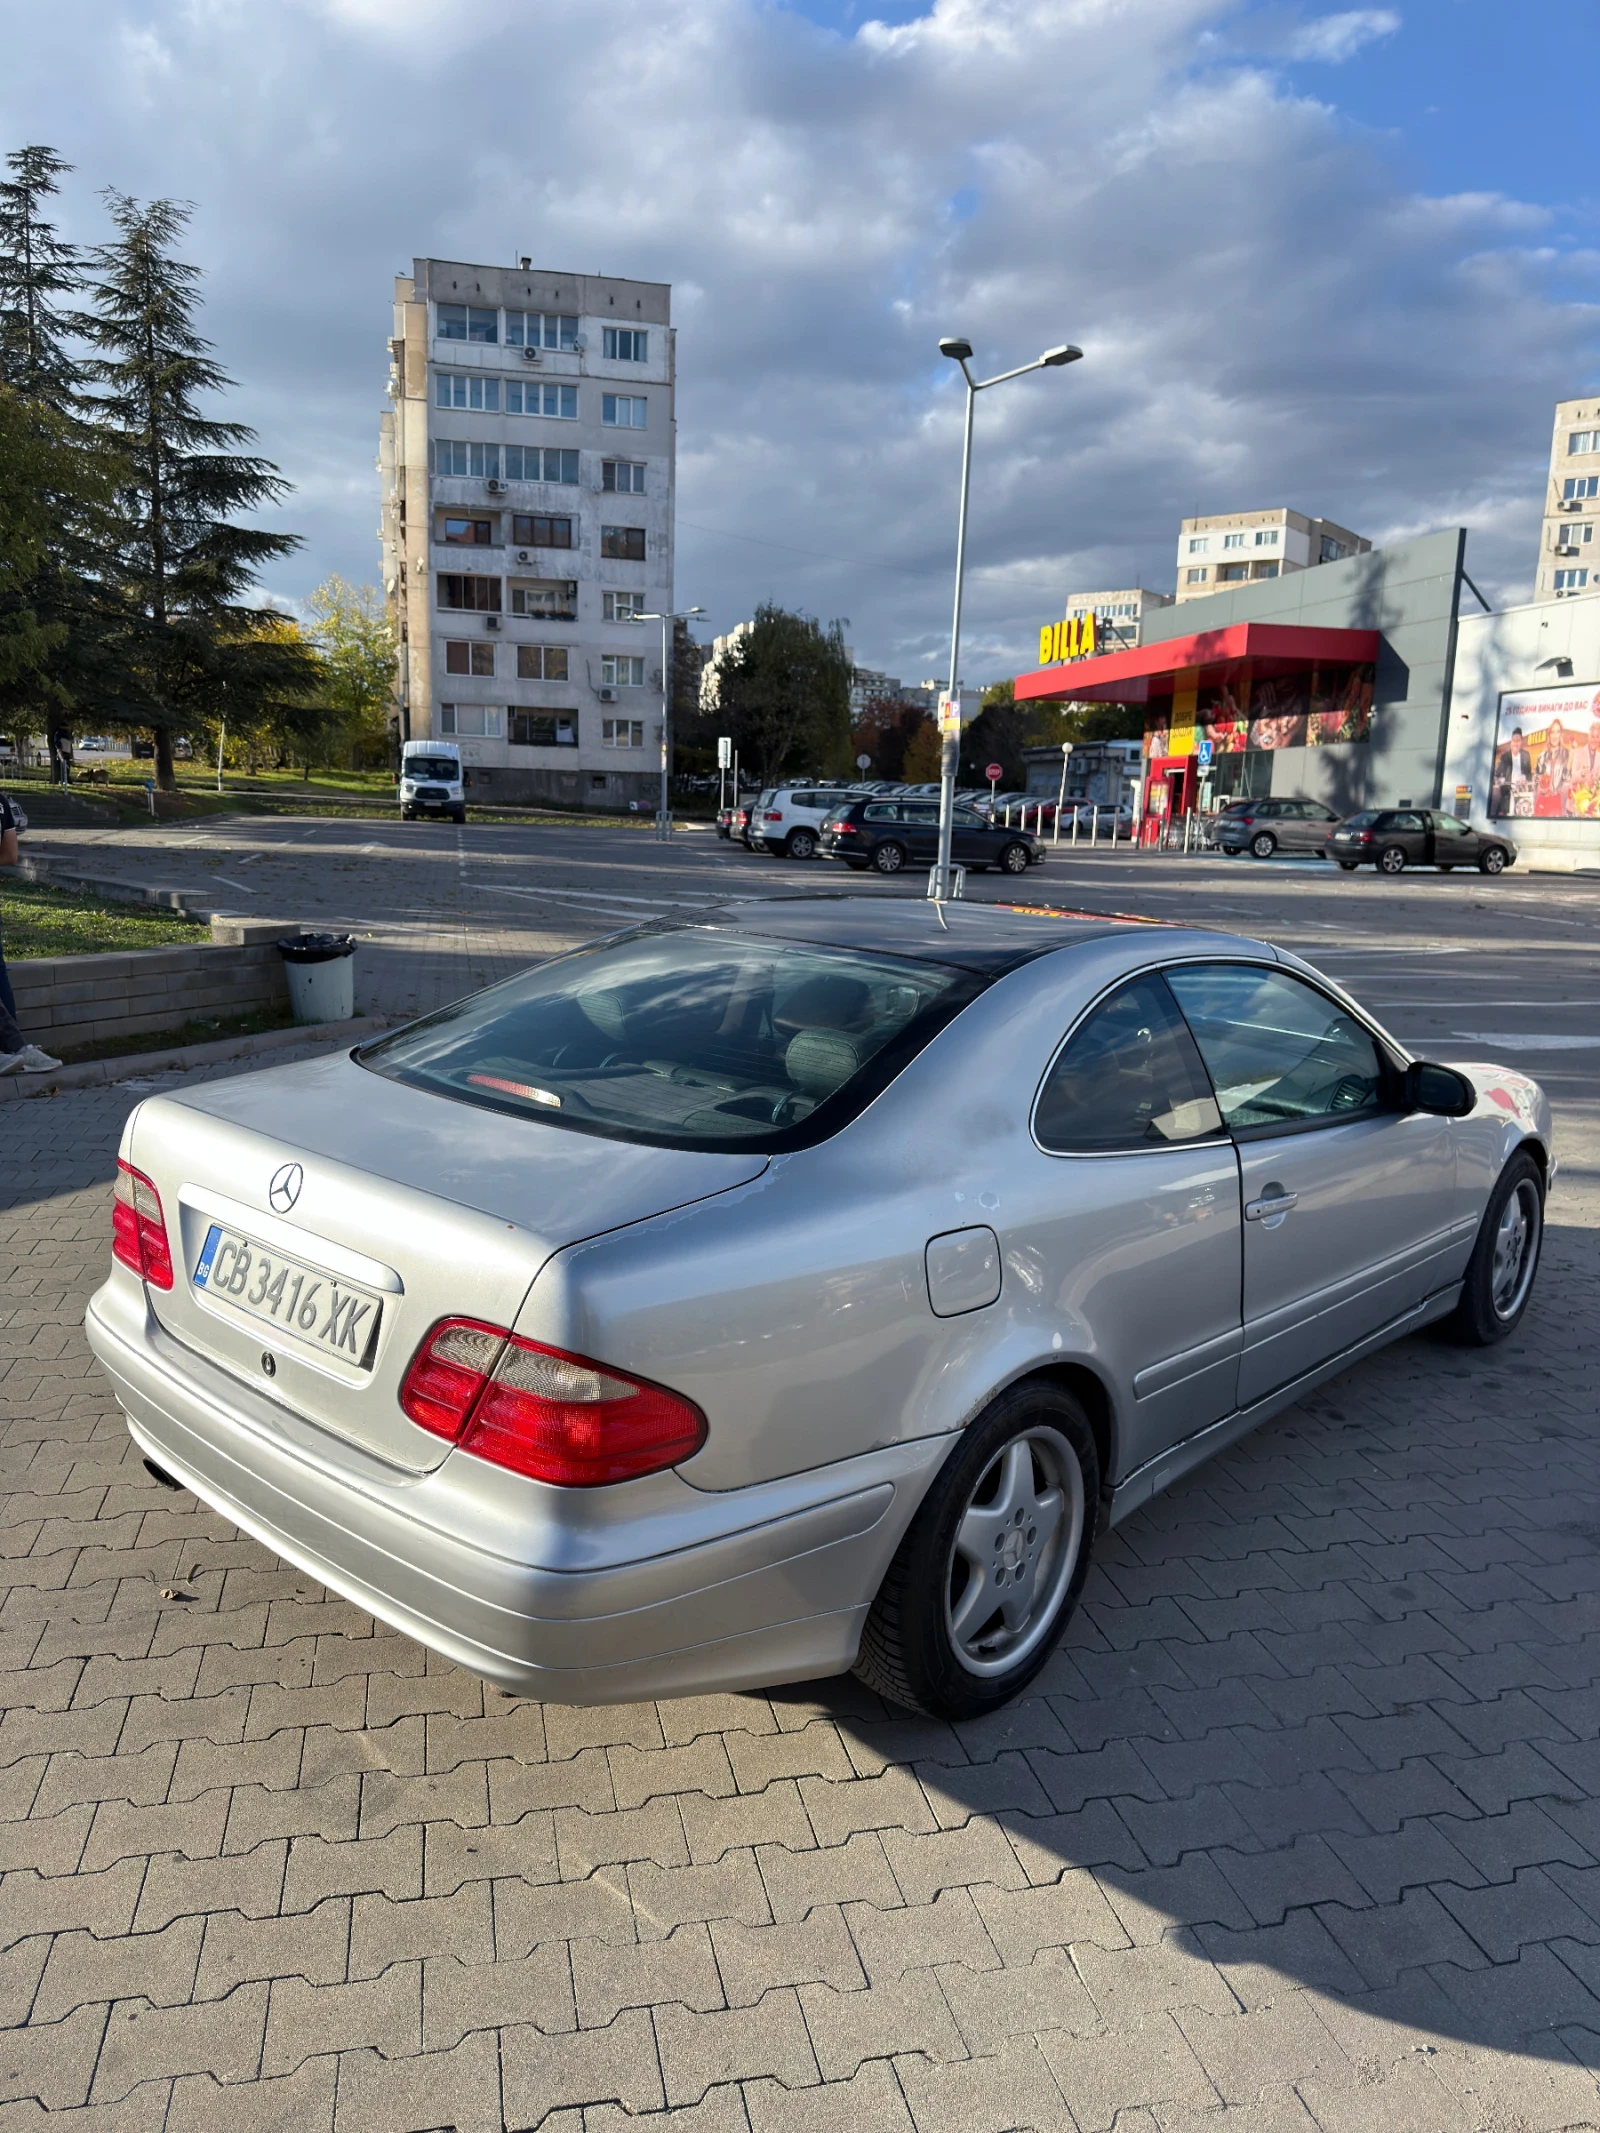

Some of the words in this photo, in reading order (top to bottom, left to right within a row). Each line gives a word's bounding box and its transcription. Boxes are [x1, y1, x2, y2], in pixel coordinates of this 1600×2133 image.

[1039, 613, 1095, 665] BILLA
[197, 1261, 210, 1278] BG
[213, 1240, 252, 1295] CB
[248, 1257, 322, 1330] 3416
[318, 1289, 371, 1354] XK
